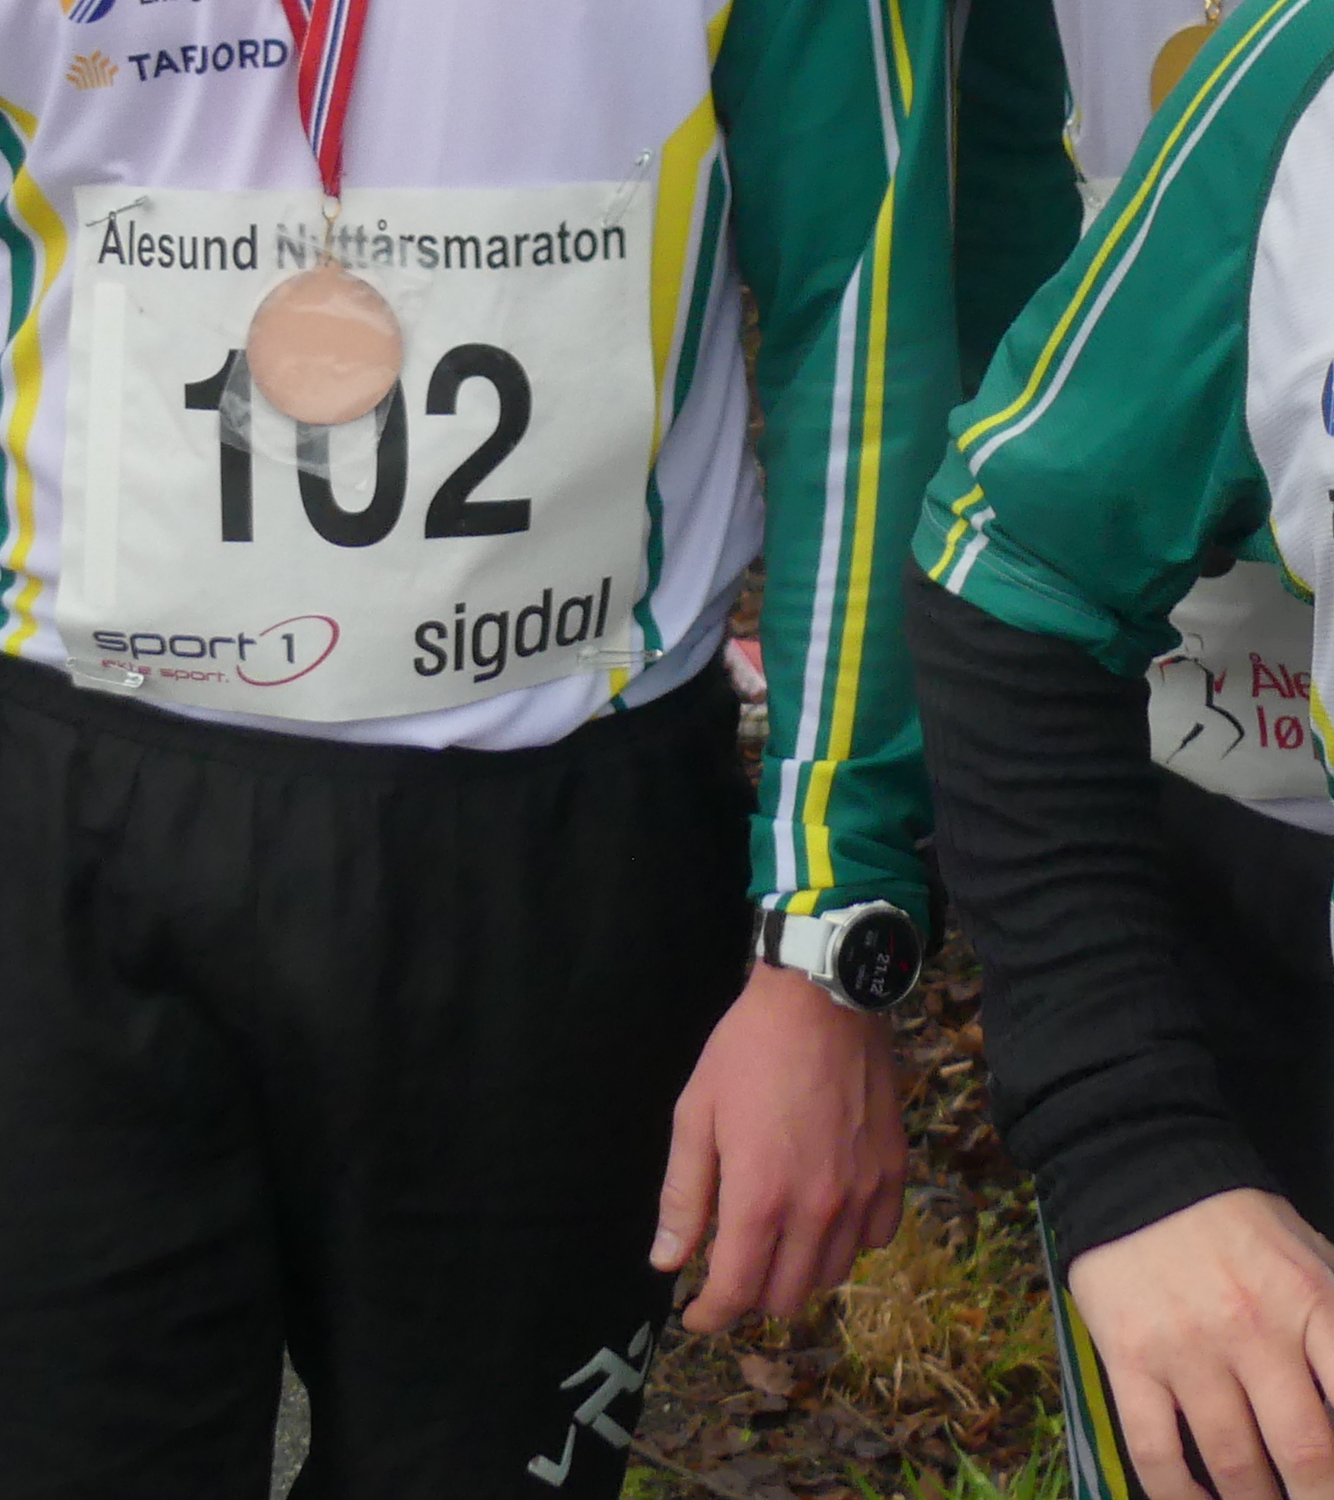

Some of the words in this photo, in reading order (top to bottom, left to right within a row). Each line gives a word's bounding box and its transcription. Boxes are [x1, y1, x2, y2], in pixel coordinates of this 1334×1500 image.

[129, 39, 288, 81] TAFJORD
[98, 212, 258, 270] Ålesund
[184, 342, 533, 548] 102
[93, 631, 257, 661] sport
[282, 632, 296, 664] 1
[413, 576, 612, 683] sigdal
[1249, 652, 1310, 700] Åle
